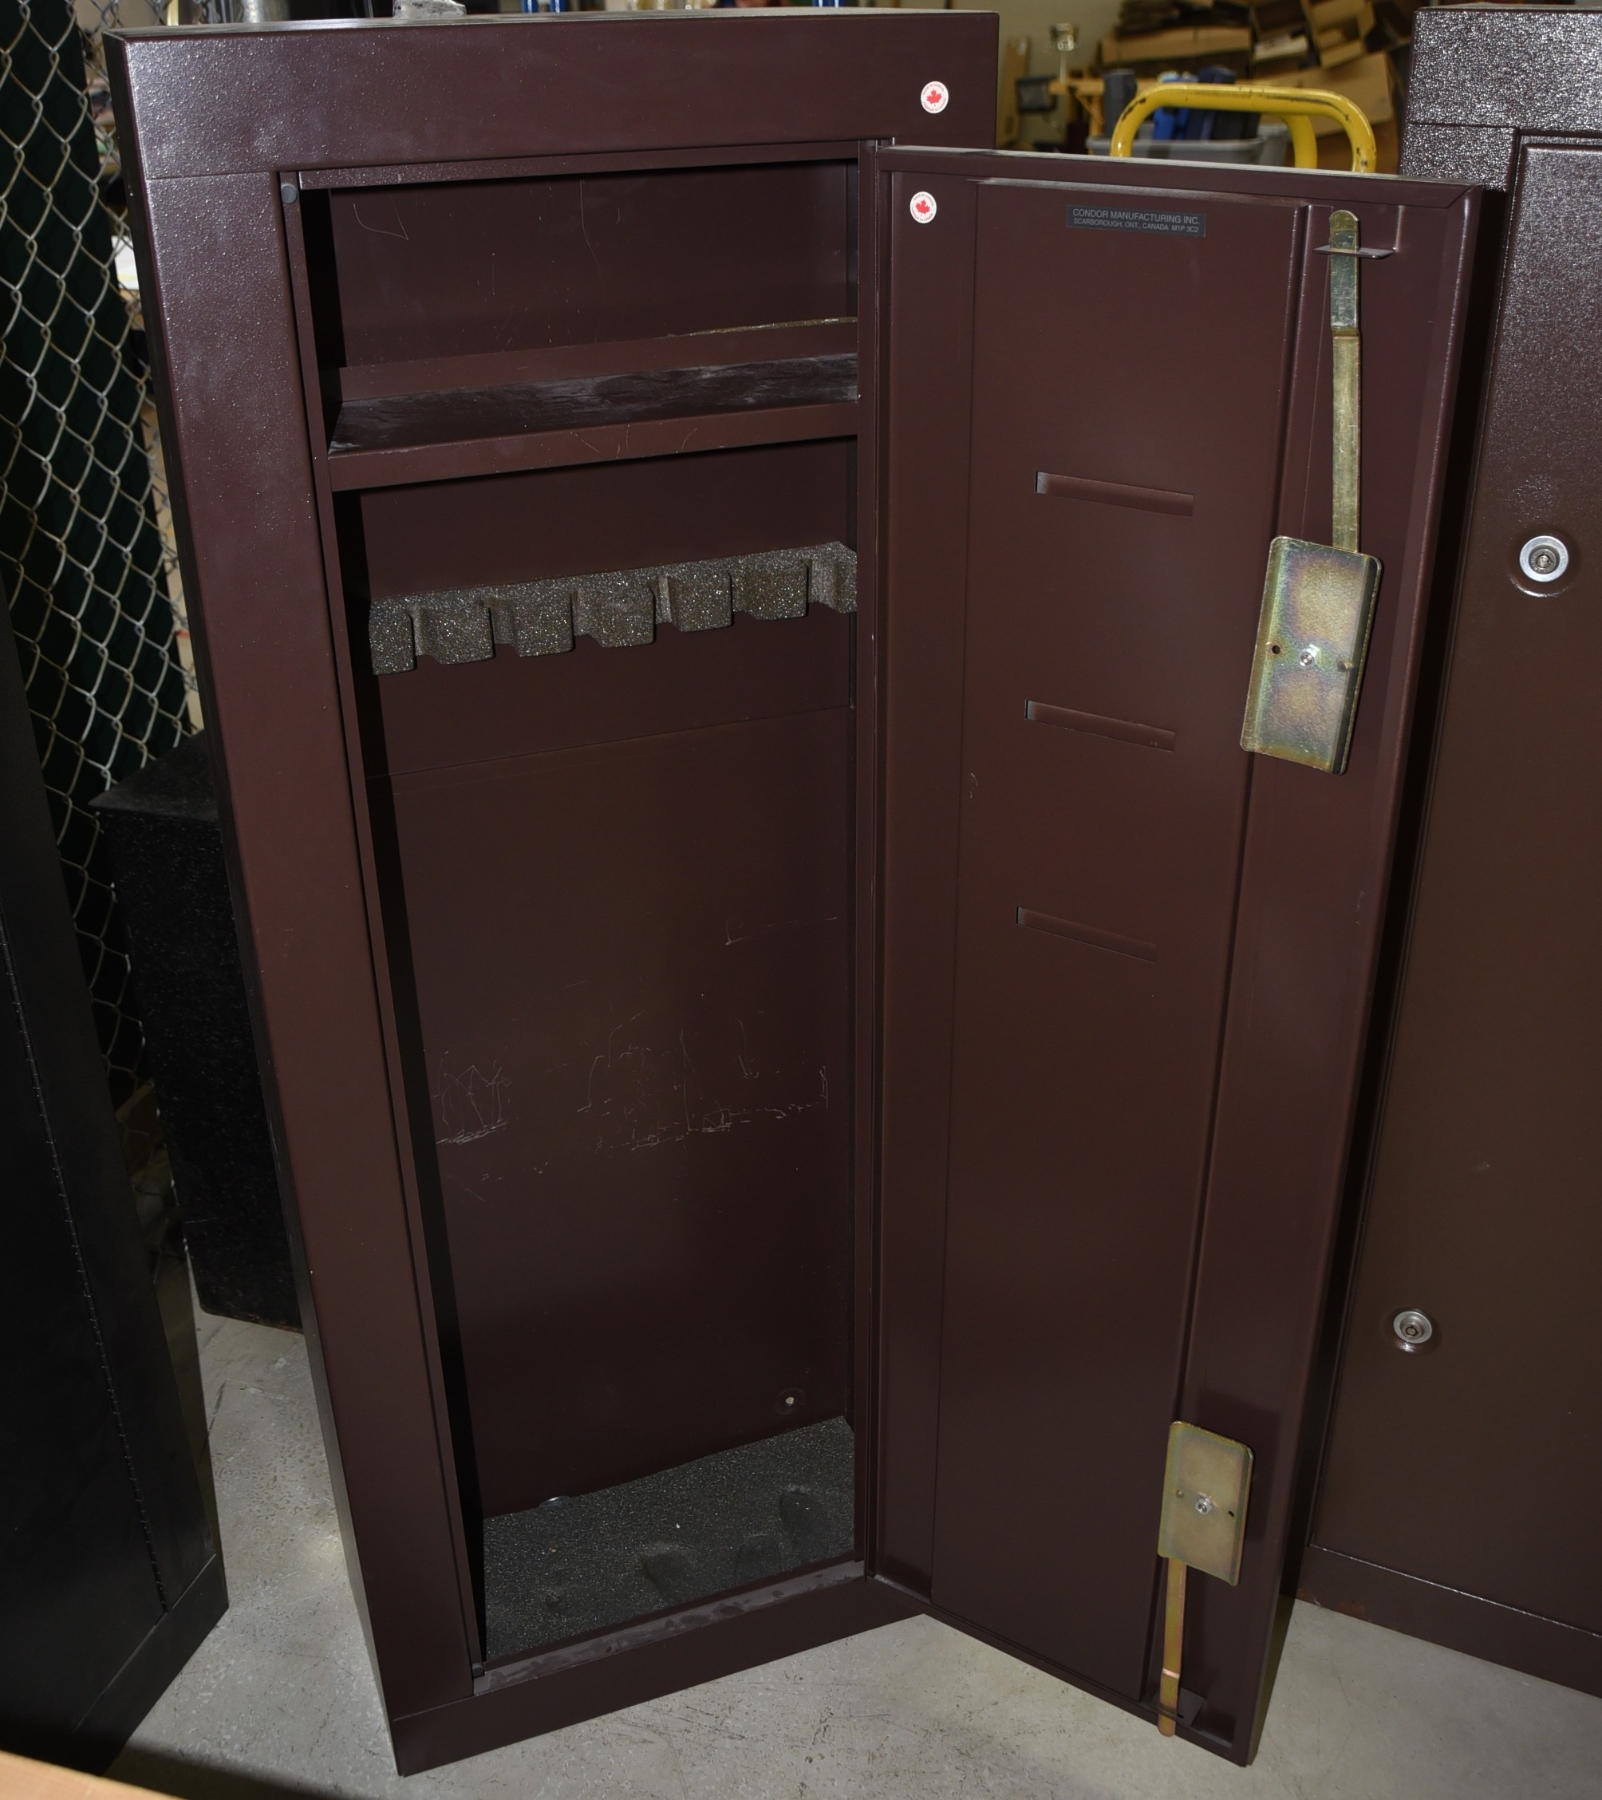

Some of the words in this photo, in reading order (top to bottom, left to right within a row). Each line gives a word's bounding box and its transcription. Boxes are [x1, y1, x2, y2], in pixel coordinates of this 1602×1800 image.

[1072, 208, 1108, 218] CONDOR
[1110, 211, 1181, 224] MANUFACTURING
[1183, 216, 1200, 225] INC.
[1143, 223, 1168, 231] CANADA
